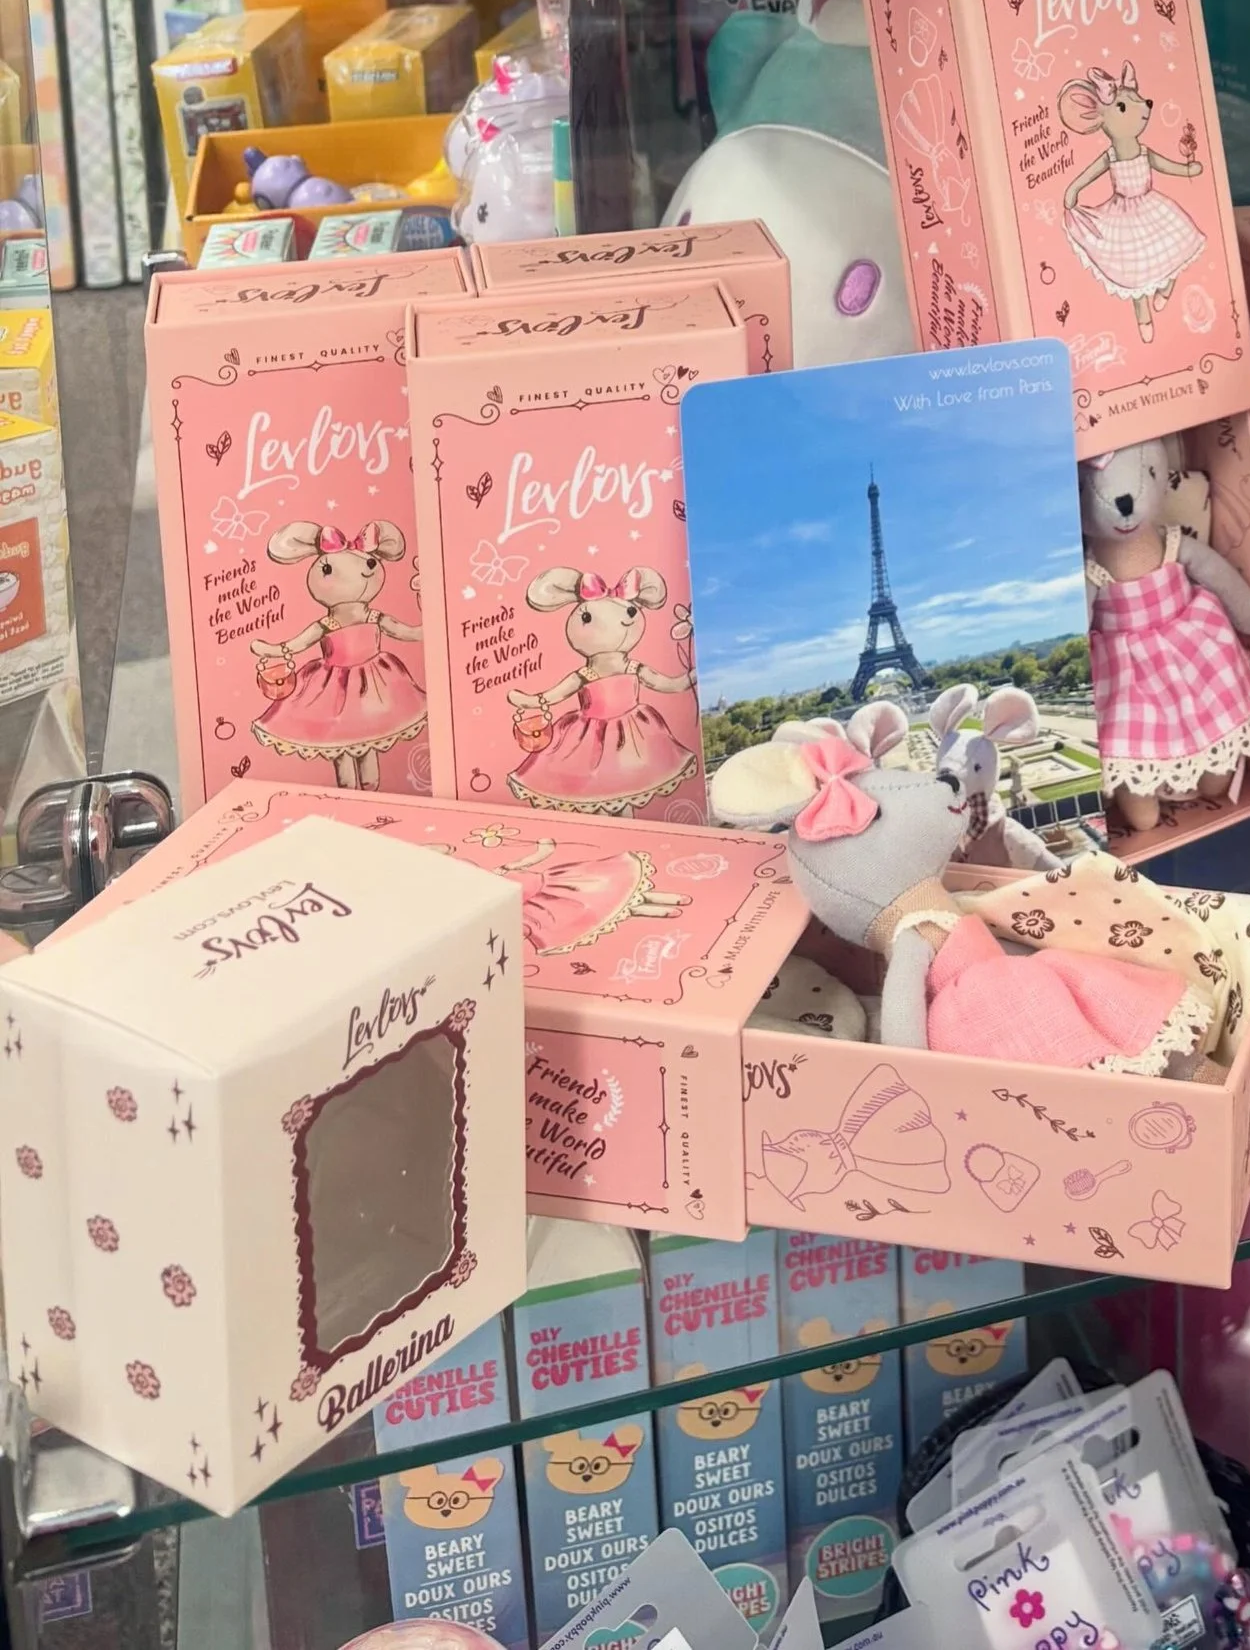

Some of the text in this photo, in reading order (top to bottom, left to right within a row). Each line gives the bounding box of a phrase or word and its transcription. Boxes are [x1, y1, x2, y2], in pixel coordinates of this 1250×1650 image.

[1011, 104, 1049, 136] Friends
[1024, 124, 1051, 149] make
[1019, 130, 1070, 172] the World
[1025, 149, 1075, 190] Beautiful
[255, 343, 381, 364] FINEST QUALITY
[928, 353, 1054, 381] www.levlovs.com
[518, 381, 647, 402] FINEST QUALITY
[893, 394, 931, 413] With
[936, 390, 974, 407] Love
[976, 384, 1014, 401] from
[236, 404, 397, 501] Levlovs
[497, 445, 663, 544] Levlovs
[203, 558, 258, 591] Friends
[208, 584, 281, 628] the World
[217, 579, 258, 605] make
[215, 603, 286, 646] Beautiful
[460, 605, 516, 638] Friends
[465, 631, 540, 676] the World
[475, 626, 516, 652] make
[471, 652, 544, 694] Beautiful
[200, 882, 353, 962] Levlovs
[342, 987, 420, 1071] Levlovs
[526, 1055, 607, 1105] Friends
[679, 1073, 689, 1119] FINEST
[528, 1089, 588, 1126] make
[539, 1119, 607, 1162] World
[526, 1142, 588, 1182] utiful
[680, 1130, 691, 1187] QUALITY
[663, 1272, 694, 1292] DIY
[789, 1255, 888, 1293] CUTIES
[658, 1274, 771, 1315] CHENILLE
[664, 1295, 768, 1338] CUTIES
[525, 1327, 642, 1368] CHENILLE
[531, 1326, 562, 1347] DIY
[317, 1313, 456, 1434] Ballerina
[531, 1348, 639, 1391] CUTIES
[385, 1380, 497, 1427] CUTIES
[816, 1398, 872, 1425] BEARY
[817, 1416, 872, 1442] SWEET
[693, 1443, 752, 1472] BEARY
[795, 1434, 895, 1471] DOUX OURS
[694, 1461, 753, 1491] SWEET
[817, 1462, 876, 1490] OSITOS
[673, 1480, 776, 1518] DOUX OURS
[815, 1479, 878, 1507] DULCES
[564, 1498, 624, 1527] BEARY
[694, 1508, 757, 1538] OSITOS
[566, 1515, 625, 1544] SWEET
[694, 1526, 759, 1555] DULCES
[424, 1533, 485, 1562] BEARY
[544, 1535, 650, 1573] DOUX OURS
[819, 1532, 886, 1561] BRIGHT
[426, 1551, 487, 1580] SWEET
[566, 1562, 629, 1592] OSITOS
[817, 1549, 890, 1581] STRIPES
[404, 1569, 513, 1609] DOUX OURS
[731, 1580, 768, 1611] IGHT
